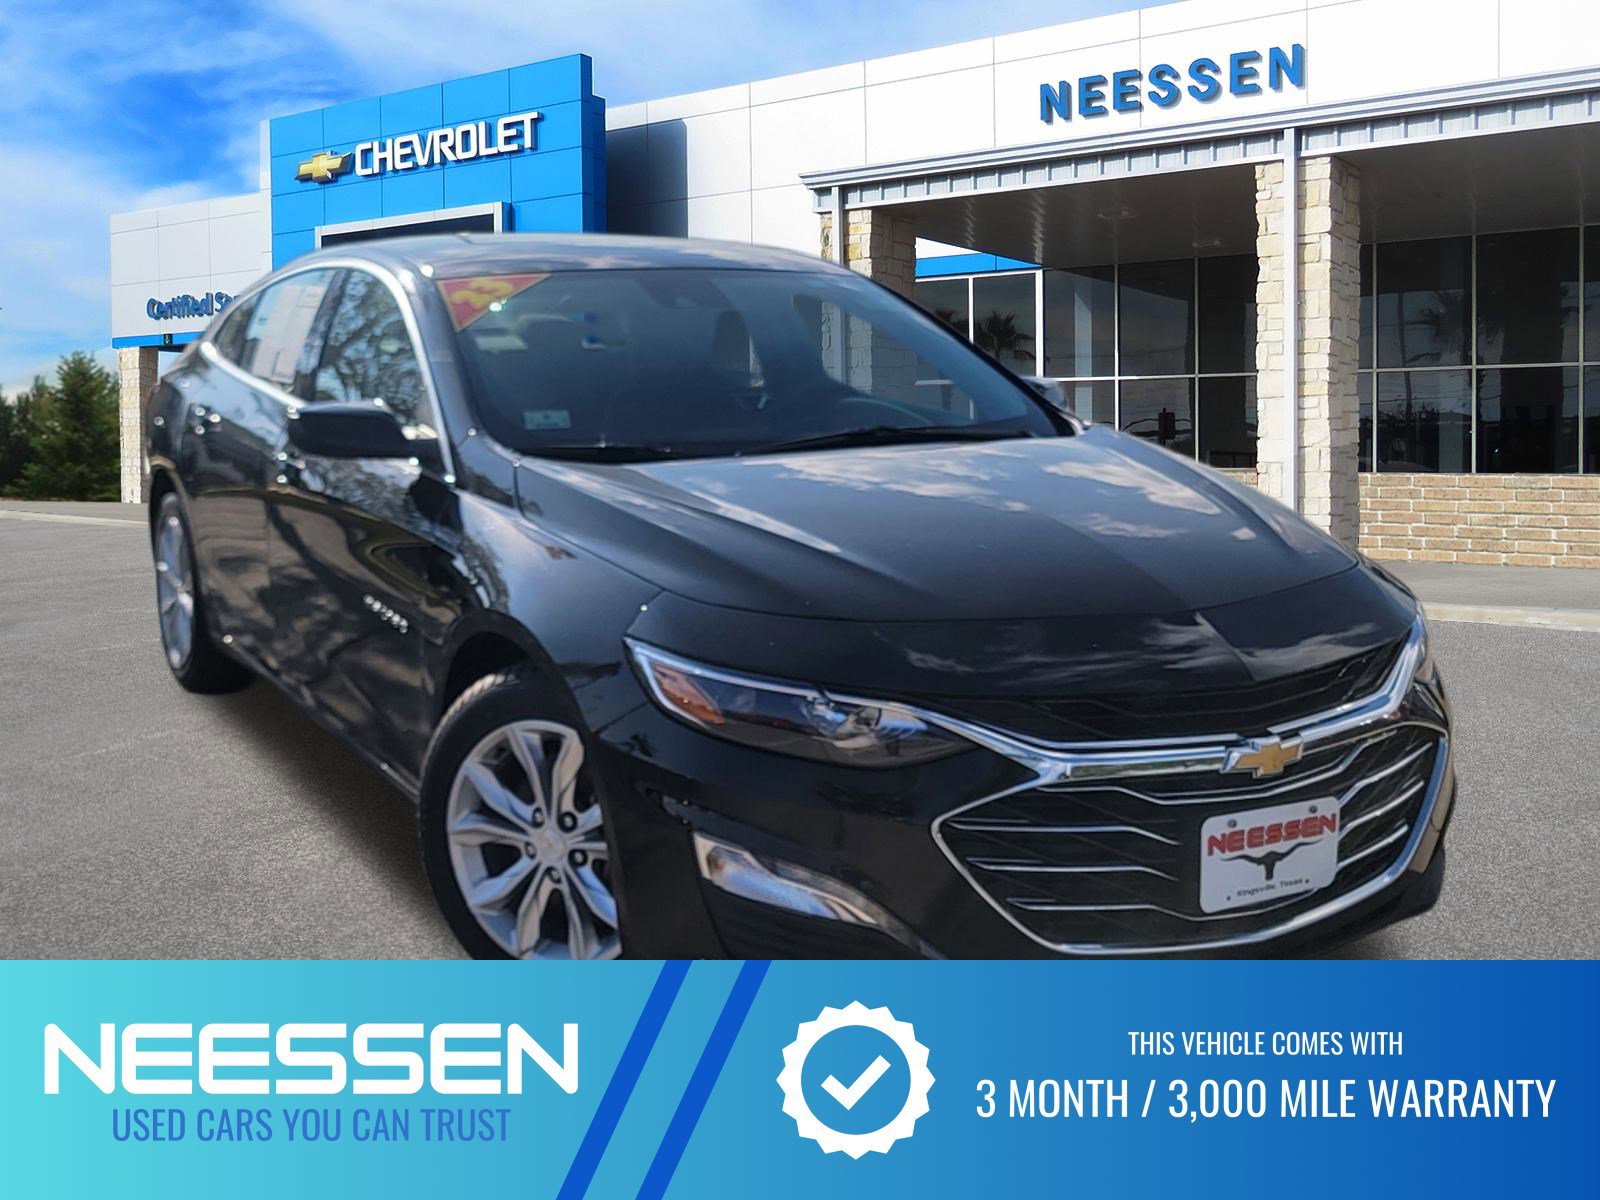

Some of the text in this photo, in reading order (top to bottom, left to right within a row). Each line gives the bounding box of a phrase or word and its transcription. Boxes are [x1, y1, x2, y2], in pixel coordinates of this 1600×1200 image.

[1040, 43, 1305, 122] NEESSEN
[355, 111, 542, 177] CHEVROLET
[147, 292, 213, 320] Certified
[1207, 813, 1337, 857] NEESSEN
